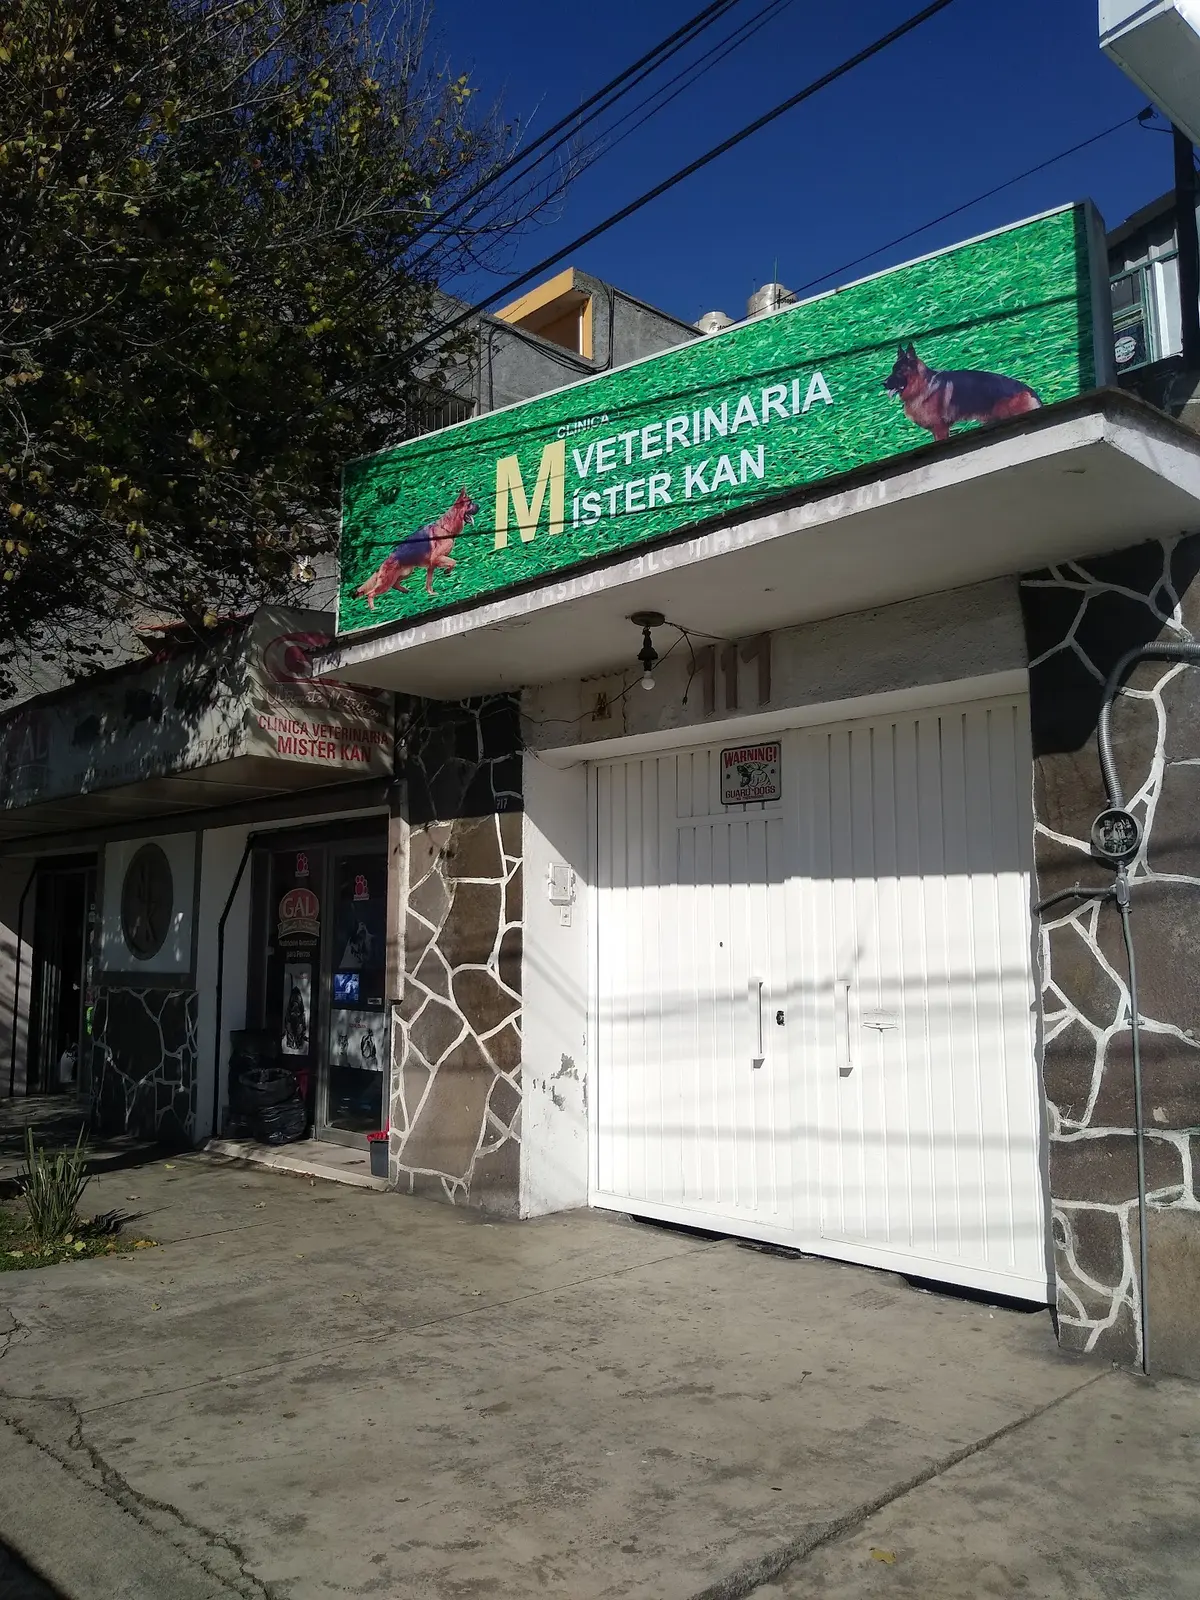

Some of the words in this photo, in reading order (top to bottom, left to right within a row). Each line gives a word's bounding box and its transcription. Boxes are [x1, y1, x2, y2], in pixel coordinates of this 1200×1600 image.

[557, 413, 610, 439] CLINICA
[572, 371, 834, 479] VETERINARIA
[685, 444, 766, 500] KAN
[258, 715, 309, 736] CLINICA
[312, 723, 389, 745] VETERINARIA
[277, 735, 336, 760] MISTER
[340, 743, 372, 763] KAN
[723, 746, 778, 769] WARNING!
[725, 788, 751, 799] GUARD
[754, 785, 776, 796] DOGS
[282, 896, 316, 919] GAL
